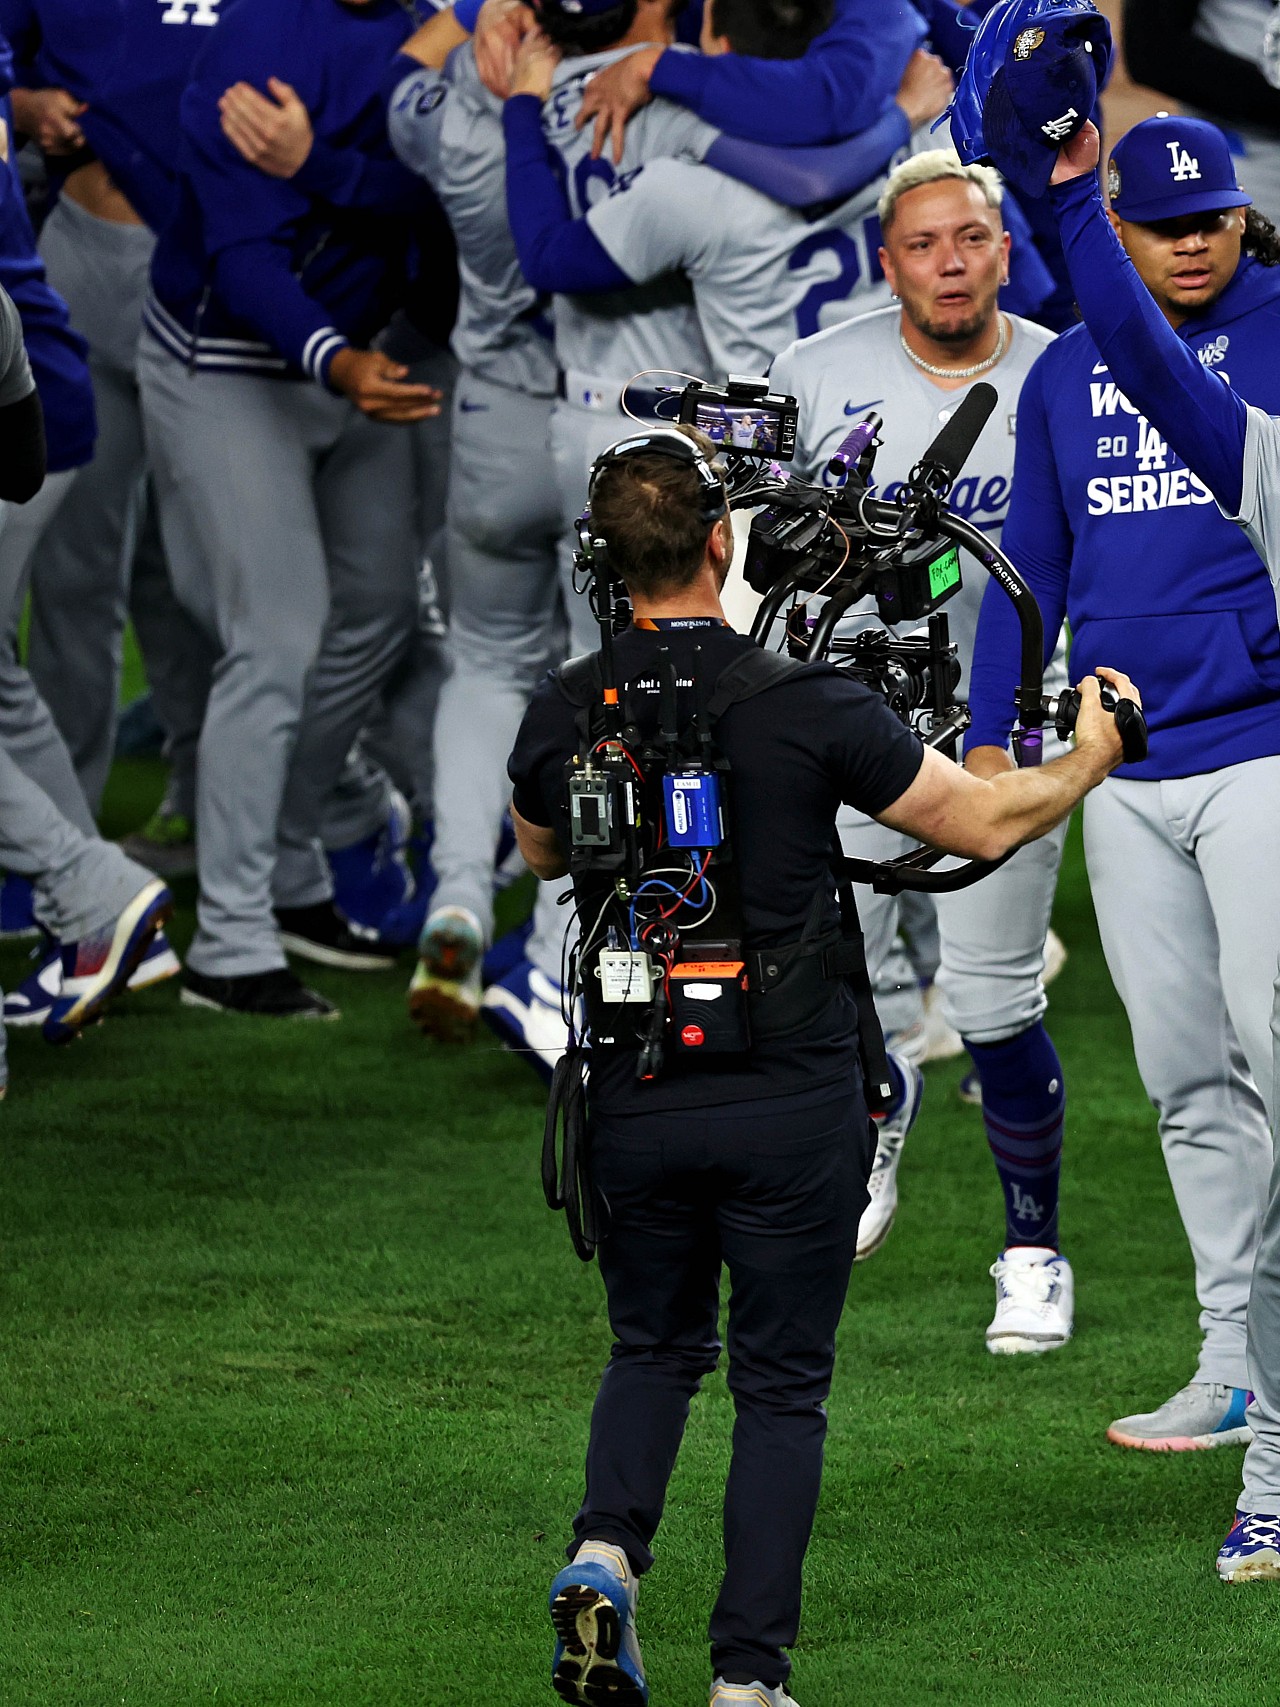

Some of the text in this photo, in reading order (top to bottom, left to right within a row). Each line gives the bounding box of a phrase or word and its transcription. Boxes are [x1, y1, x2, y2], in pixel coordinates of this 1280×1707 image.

[1166, 141, 1201, 181] LA
[1135, 415, 1167, 471] LA
[1086, 467, 1215, 516] SERIES
[992, 561, 1022, 596] FACTION
[1010, 1181, 1044, 1220] LA
